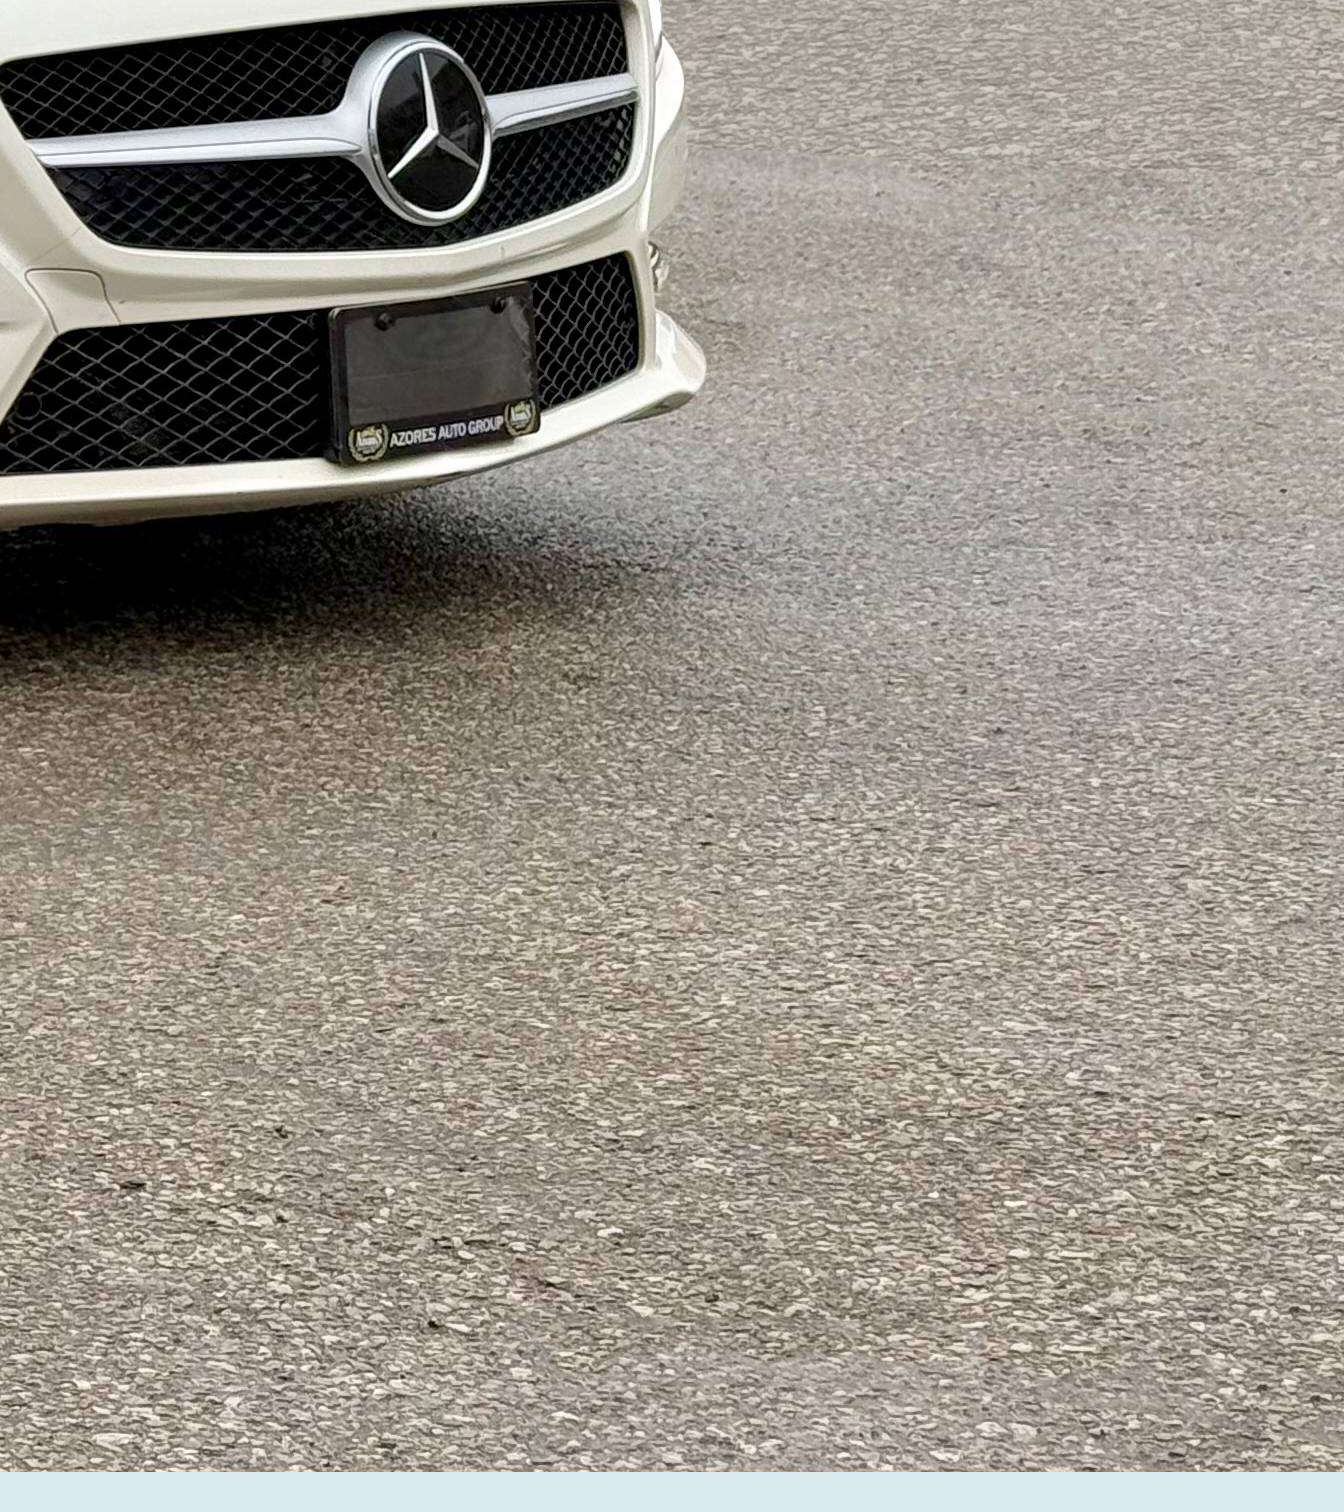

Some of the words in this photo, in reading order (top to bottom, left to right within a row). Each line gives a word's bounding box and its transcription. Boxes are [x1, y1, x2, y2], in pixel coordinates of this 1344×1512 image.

[389, 426, 437, 448] AZORES
[437, 422, 467, 440] AUTO
[467, 414, 505, 436] GROUP
